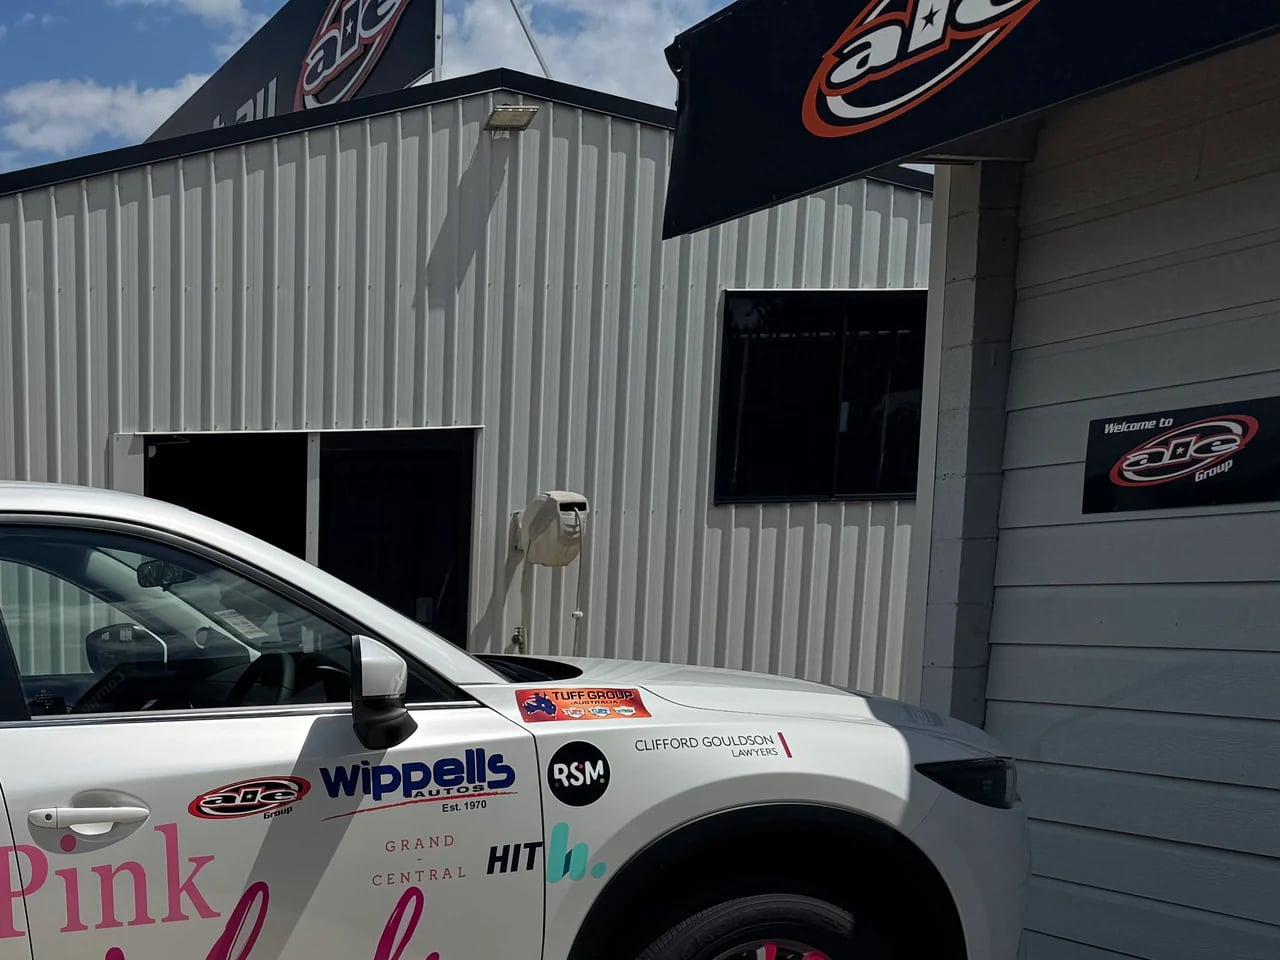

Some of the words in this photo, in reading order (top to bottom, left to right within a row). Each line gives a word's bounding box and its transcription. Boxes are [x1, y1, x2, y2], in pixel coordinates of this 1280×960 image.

[1104, 419, 1156, 434] Welcome
[1159, 417, 1173, 428] to
[1194, 459, 1233, 482] Group
[552, 691, 585, 700] TUFF
[587, 690, 634, 701] GROUP
[635, 736, 699, 752] CLIFFORD
[702, 734, 775, 747] GOULDSON
[731, 747, 779, 758] LAWYERS
[553, 760, 605, 788] RSM
[414, 784, 485, 799] AUTOS
[263, 806, 293, 820] Group
[441, 804, 461, 813] Est.
[463, 800, 488, 812] 1970
[385, 834, 456, 853] GRAND
[486, 841, 544, 875] HIT
[371, 866, 467, 887] CENTRAL
